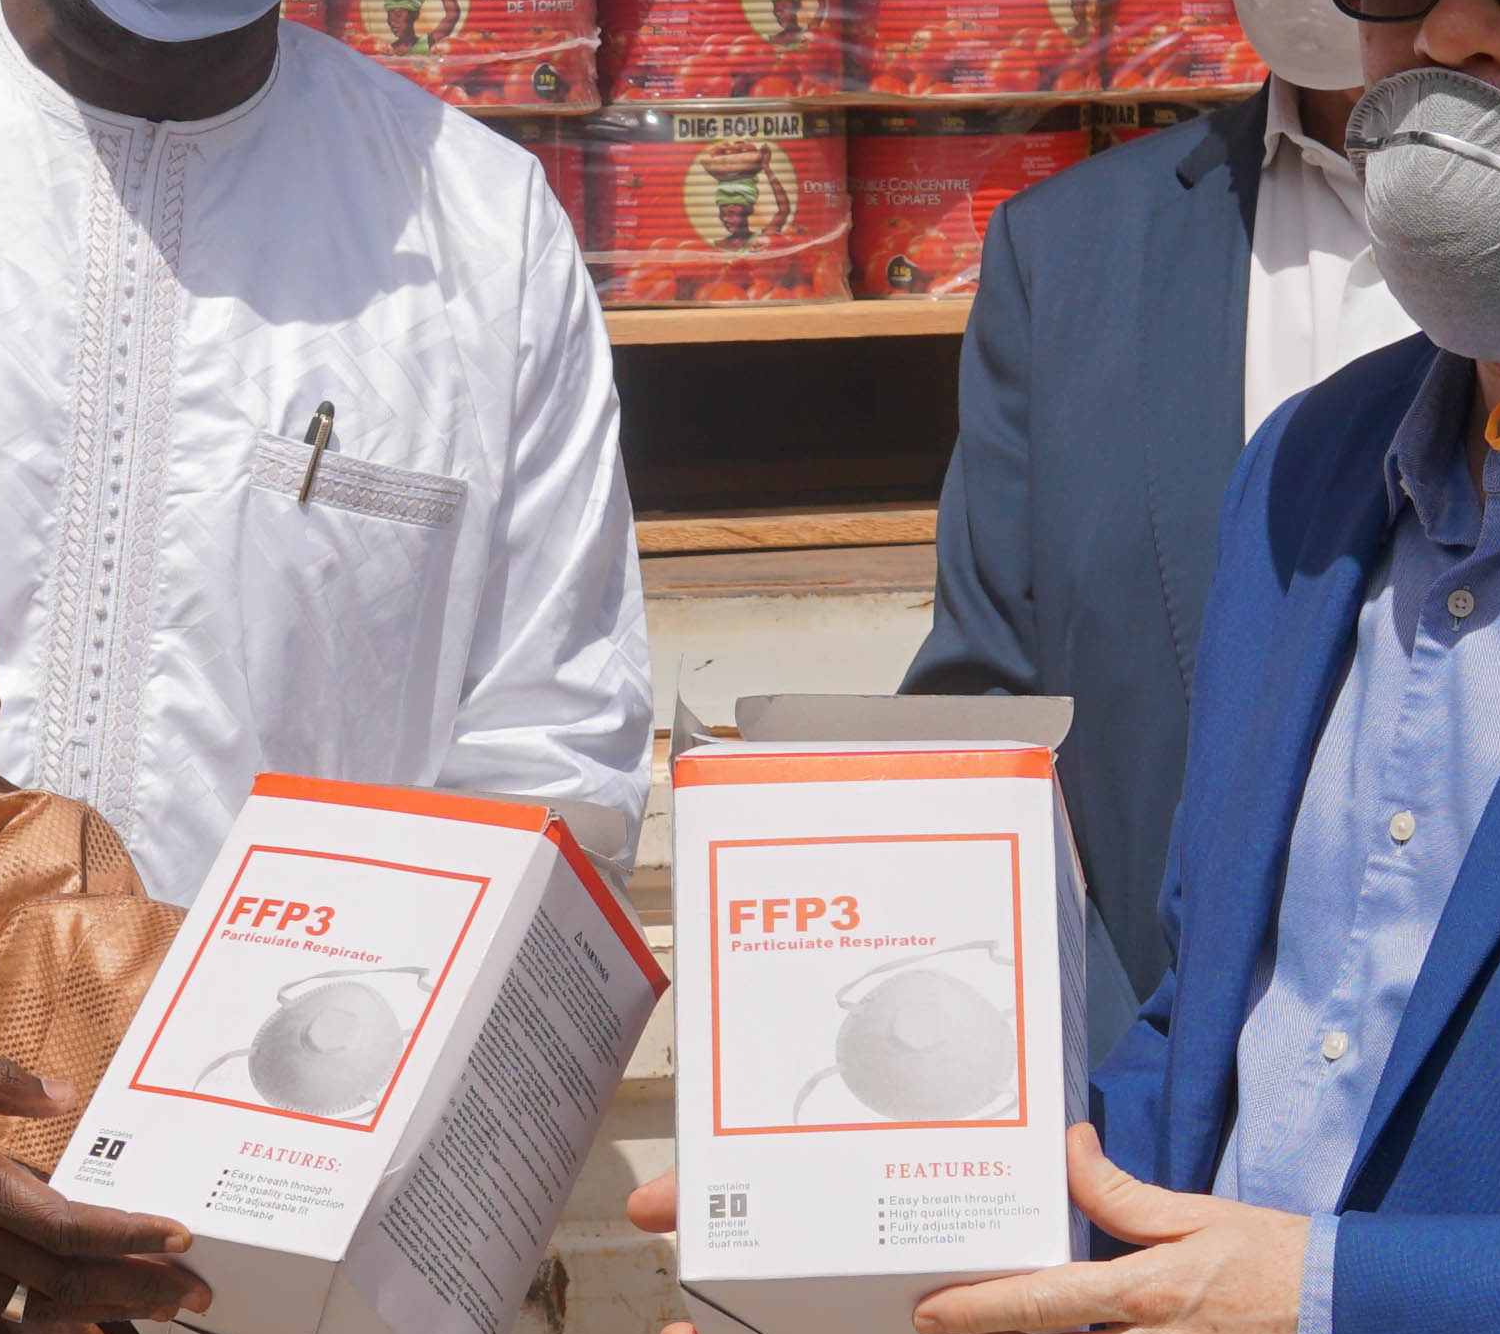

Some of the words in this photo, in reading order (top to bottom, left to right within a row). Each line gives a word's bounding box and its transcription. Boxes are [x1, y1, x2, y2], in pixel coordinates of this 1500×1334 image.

[678, 118, 717, 139] DIEG
[722, 117, 758, 138] BOU
[762, 116, 800, 136] DIAR
[227, 896, 335, 936] FFP3
[729, 896, 860, 934] FFP3
[303, 940, 382, 963] Respirator
[840, 935, 936, 950] Respirator
[89, 1137, 127, 1160] 20
[240, 1141, 342, 1172] FEATURES:
[230, 1170, 255, 1182] Easy
[257, 1173, 289, 1187] breath
[886, 1161, 1012, 1179] FEATURES:
[220, 1192, 243, 1205] Fully
[245, 1196, 296, 1214] adjustable
[298, 1207, 308, 1215] fit
[225, 1181, 248, 1194] High
[250, 1186, 280, 1200] quality
[284, 1191, 344, 1210] construction
[709, 1193, 747, 1218] 20
[889, 1195, 920, 1206] Easy
[922, 1194, 961, 1204] breath
[965, 1193, 1016, 1205] throught
[214, 1202, 274, 1220] Comfortable
[889, 1208, 917, 1220] High
[920, 1207, 960, 1219] quality
[963, 1205, 1040, 1217] construction
[708, 1219, 746, 1229] general
[889, 1222, 917, 1233] Fully
[919, 1220, 985, 1232] adjustable
[890, 1234, 965, 1245] Comfortable
